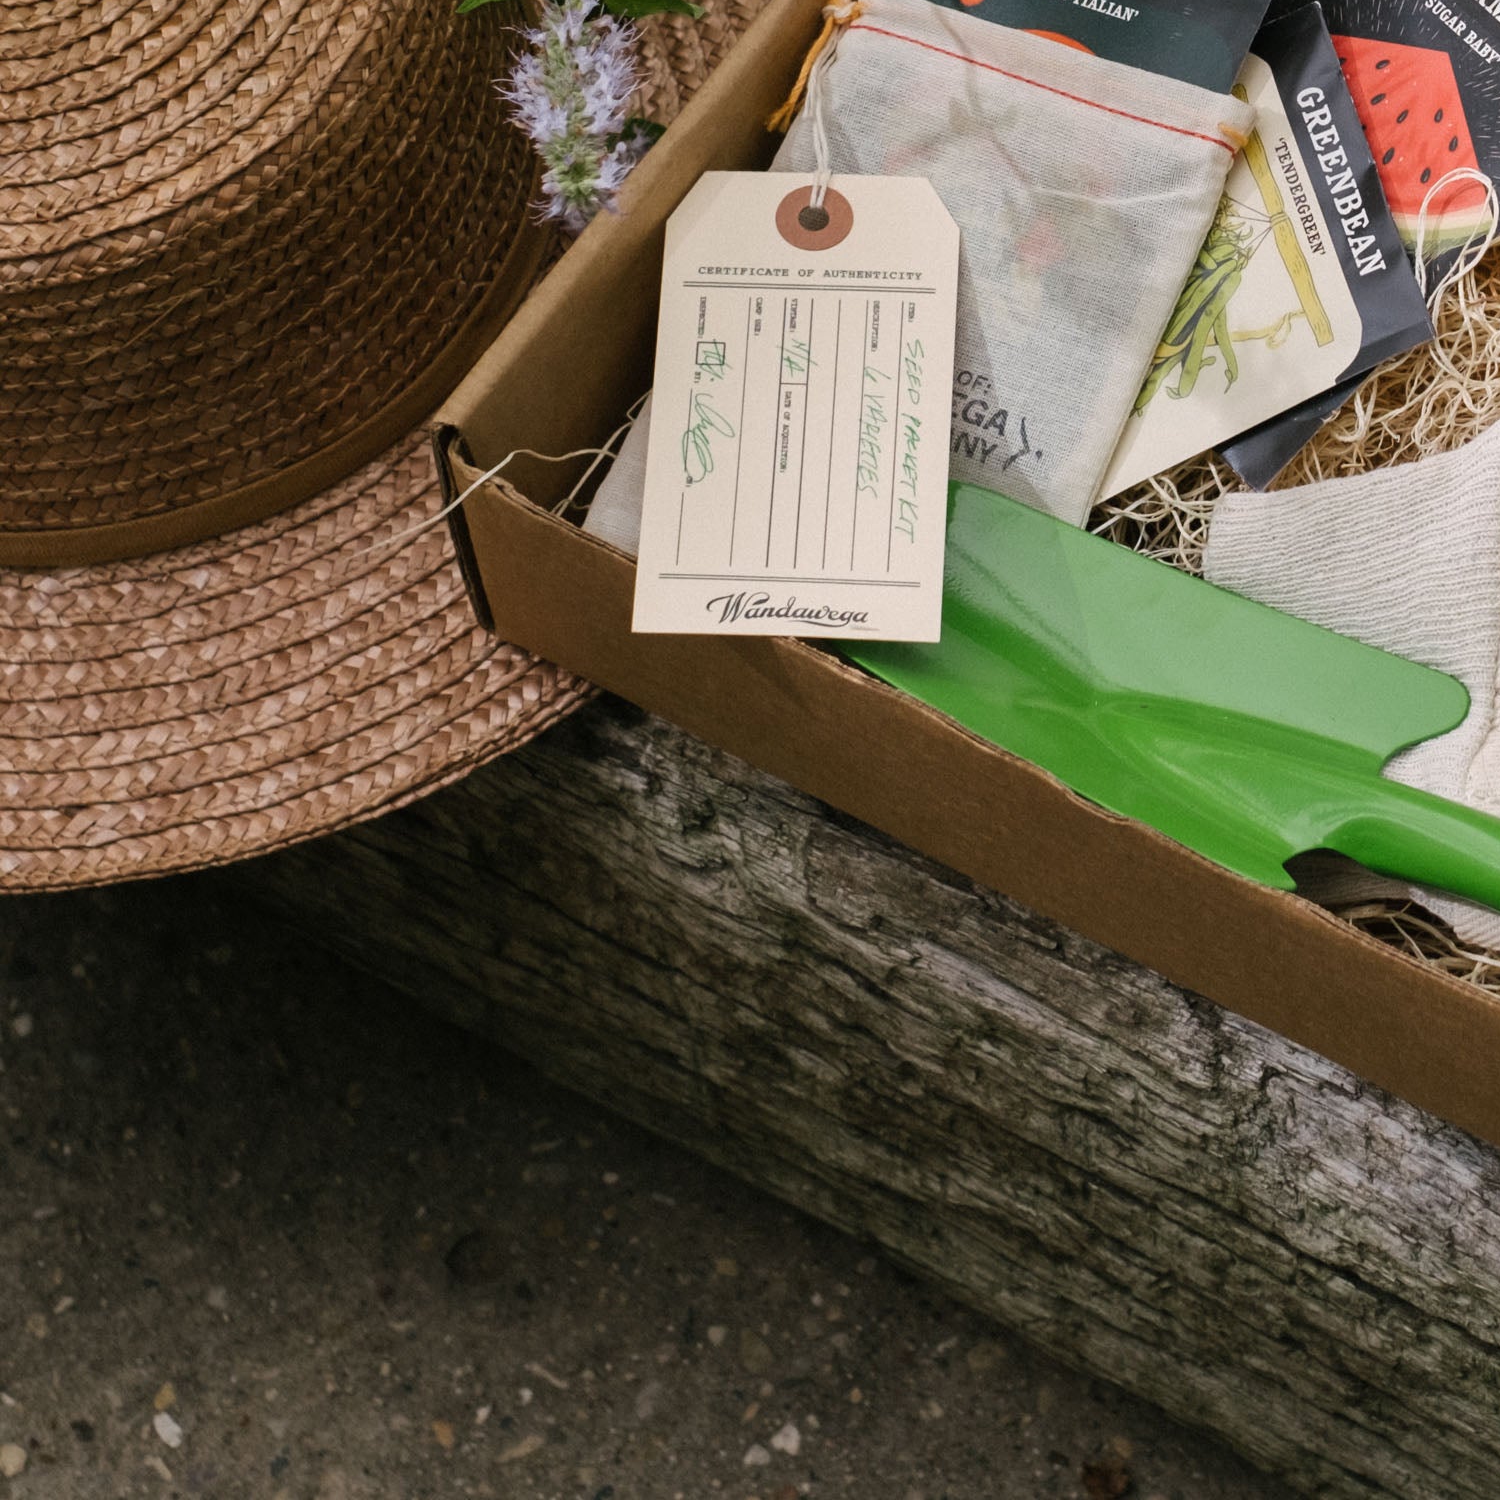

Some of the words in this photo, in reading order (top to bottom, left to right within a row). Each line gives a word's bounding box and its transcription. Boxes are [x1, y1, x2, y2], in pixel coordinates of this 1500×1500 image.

[1296, 86, 1388, 277] GREENBEAN
[697, 265, 790, 278] CERTIFICATE
[798, 268, 816, 278] OF
[822, 269, 923, 281] AUTHENTICITY
[776, 337, 819, 379] N/A
[904, 338, 926, 405] SEED
[956, 370, 992, 394] OF:
[857, 393, 888, 499] VARIETIES
[901, 411, 923, 497] PACKET
[894, 497, 919, 544] KIT
[706, 591, 870, 628] Wandawega
